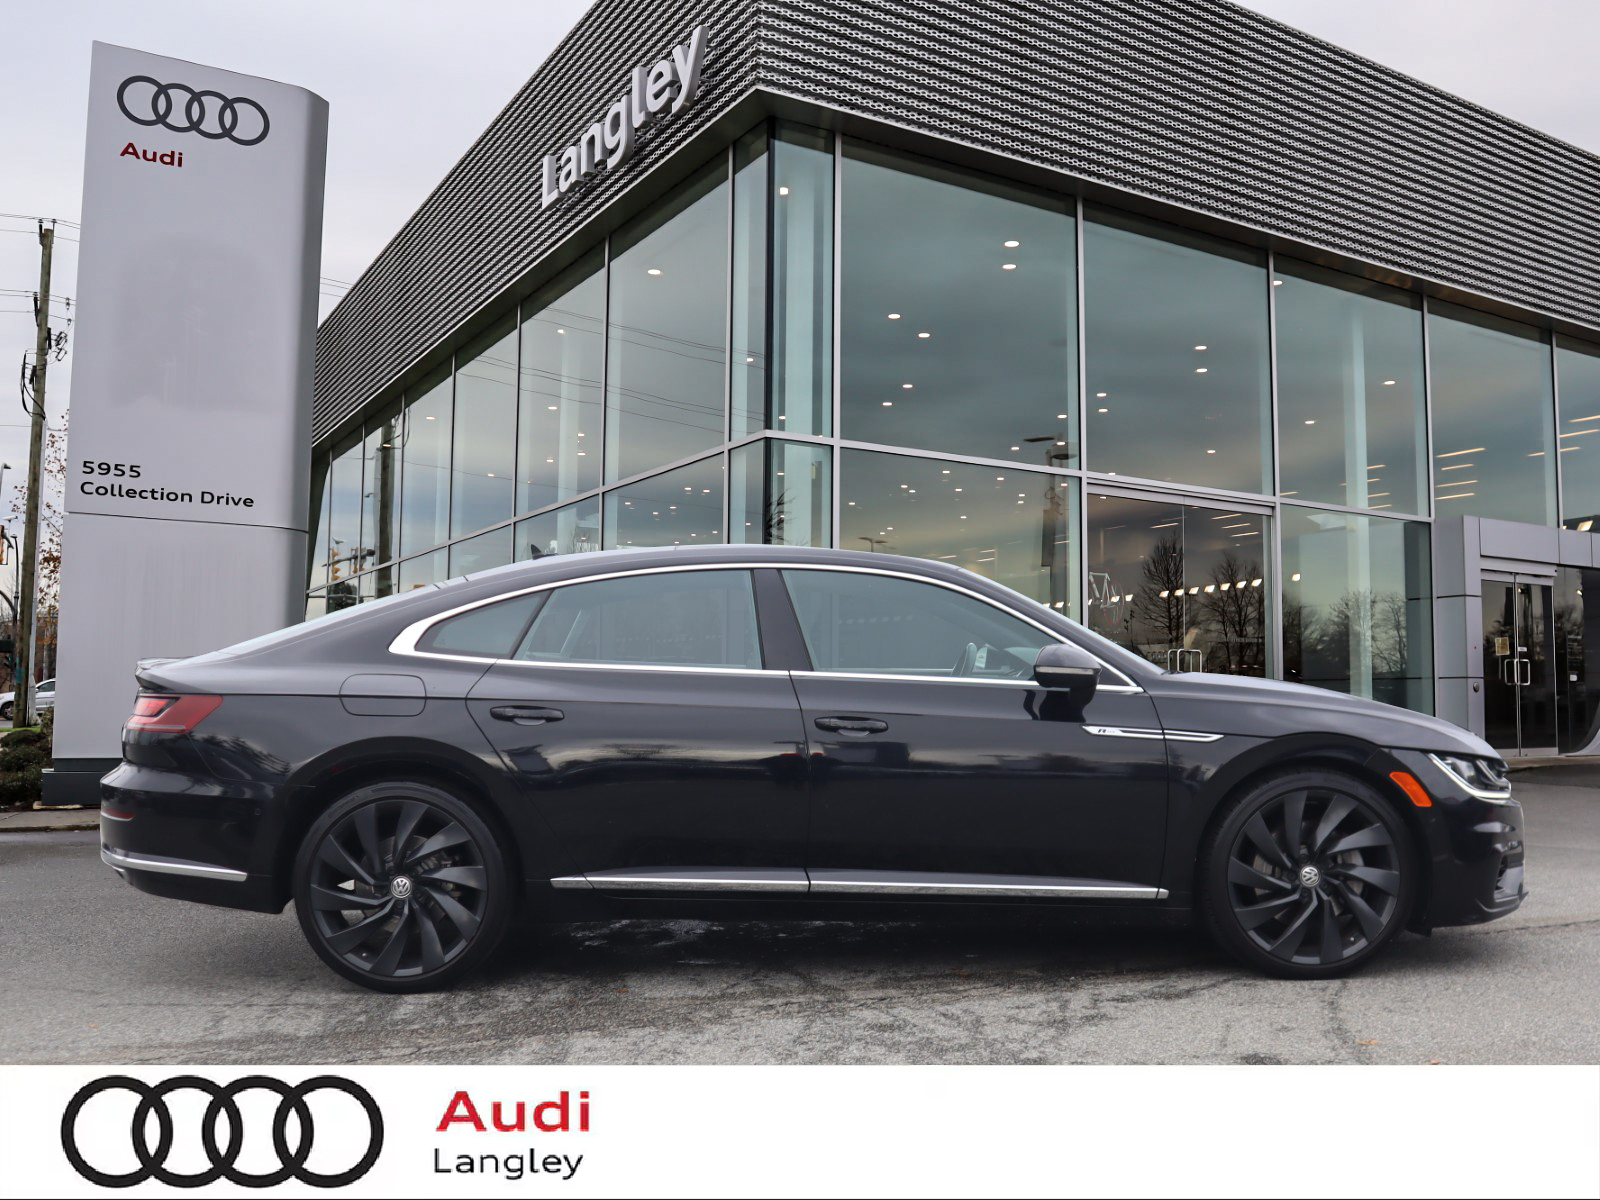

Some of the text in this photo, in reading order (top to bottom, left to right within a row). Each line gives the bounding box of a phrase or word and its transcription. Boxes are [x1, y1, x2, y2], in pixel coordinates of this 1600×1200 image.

[541, 25, 709, 210] Langley
[120, 142, 184, 168] Audi
[82, 461, 141, 479] 5955
[80, 481, 255, 508] Collection Drive
